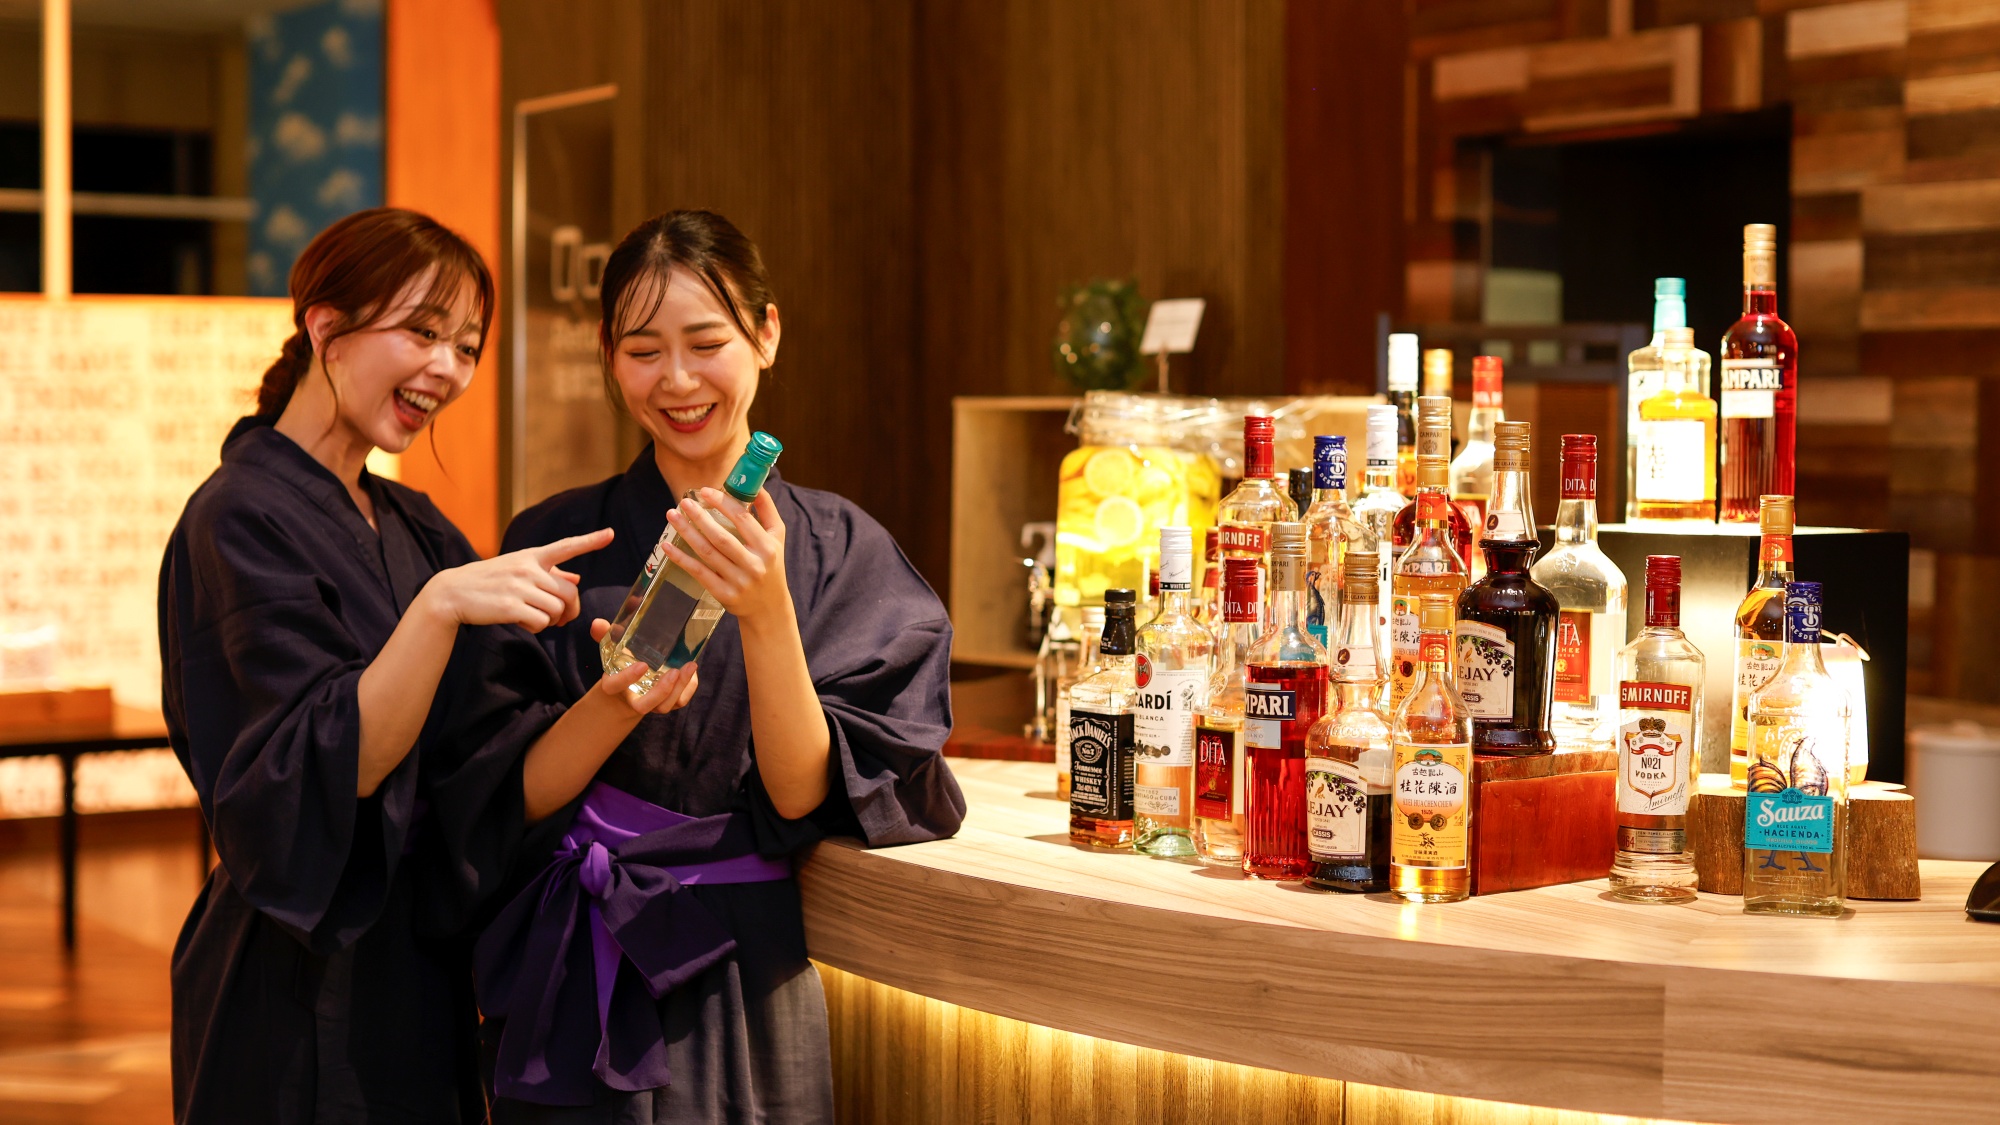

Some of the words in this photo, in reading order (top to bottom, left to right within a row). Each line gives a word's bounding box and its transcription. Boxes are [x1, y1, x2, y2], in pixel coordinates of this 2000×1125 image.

[1565, 478, 1585, 492] DITA
[1621, 687, 1688, 706] SMIRNOFF
[1201, 740, 1226, 766] DITA
[1074, 775, 1103, 786] WHISKEY
[1635, 769, 1667, 779] VODKA
[1400, 779, 1458, 796] 桂花陳酒
[1757, 799, 1825, 827] Sauza
[1313, 830, 1331, 838] CASSIS
[1764, 828, 1820, 839] HACIENDA
